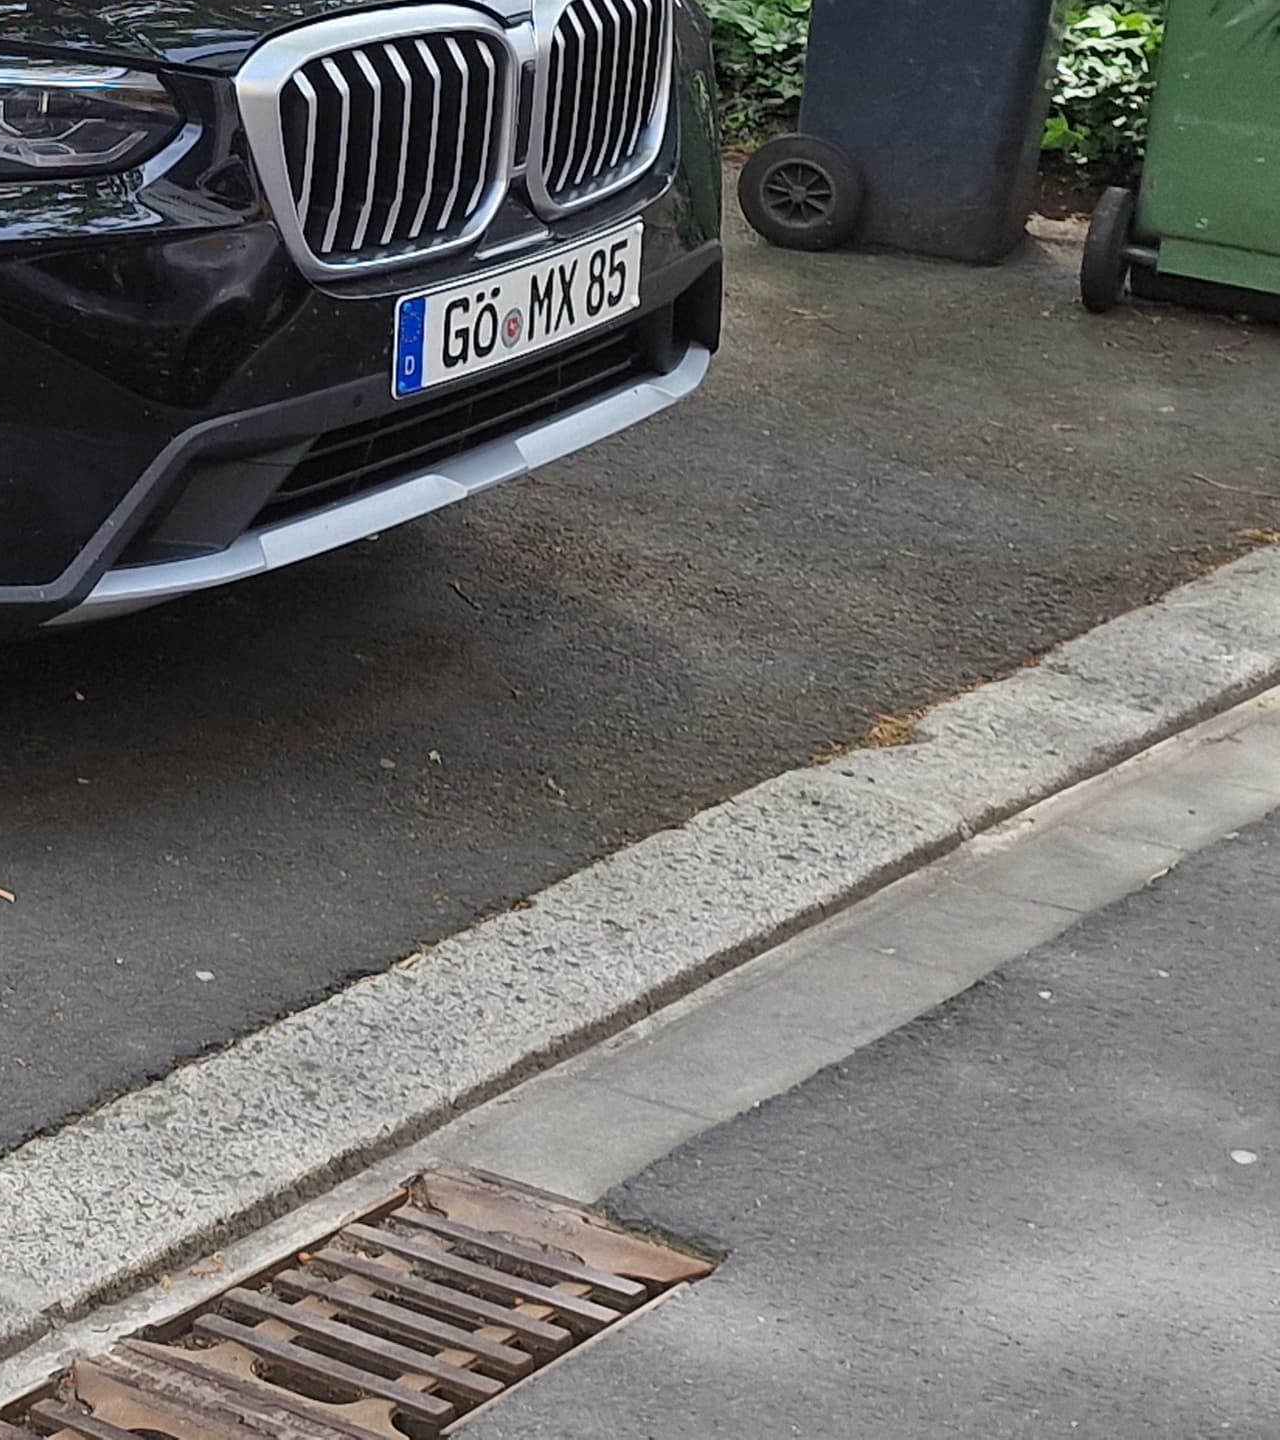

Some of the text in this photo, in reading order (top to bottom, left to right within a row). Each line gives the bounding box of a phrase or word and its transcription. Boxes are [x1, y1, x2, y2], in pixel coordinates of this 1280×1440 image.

[442, 240, 629, 369] GÖ MX 85
[403, 353, 416, 377] D
